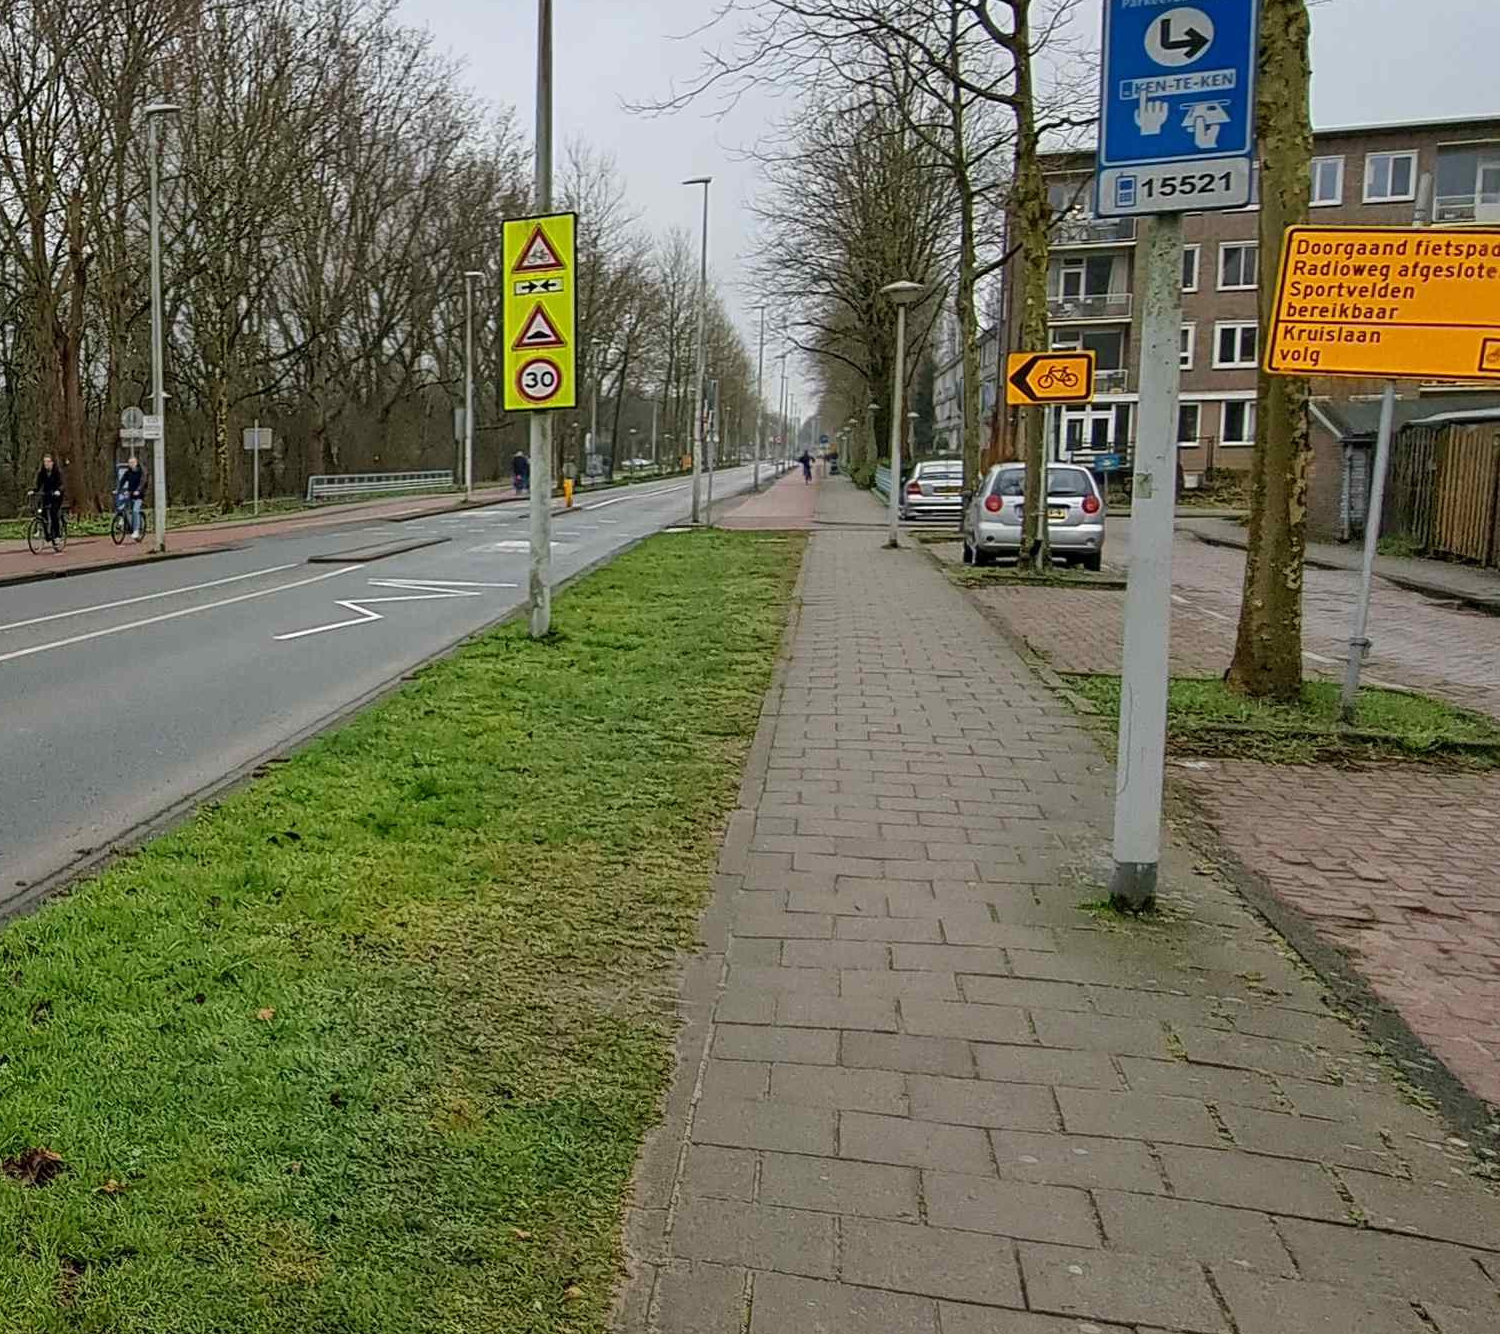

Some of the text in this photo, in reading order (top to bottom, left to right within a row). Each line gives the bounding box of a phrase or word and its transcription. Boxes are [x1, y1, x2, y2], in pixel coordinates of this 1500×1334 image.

[1140, 171, 1232, 198] 15521
[1296, 239, 1408, 260] Doorgaand
[1292, 260, 1500, 282] Radioweg afgeslote
[1290, 280, 1415, 299] Sportvelden
[1286, 302, 1399, 320] bereikbaar
[1283, 325, 1381, 343] Kruislaan
[1279, 347, 1321, 367] volg
[524, 371, 555, 389] 30
